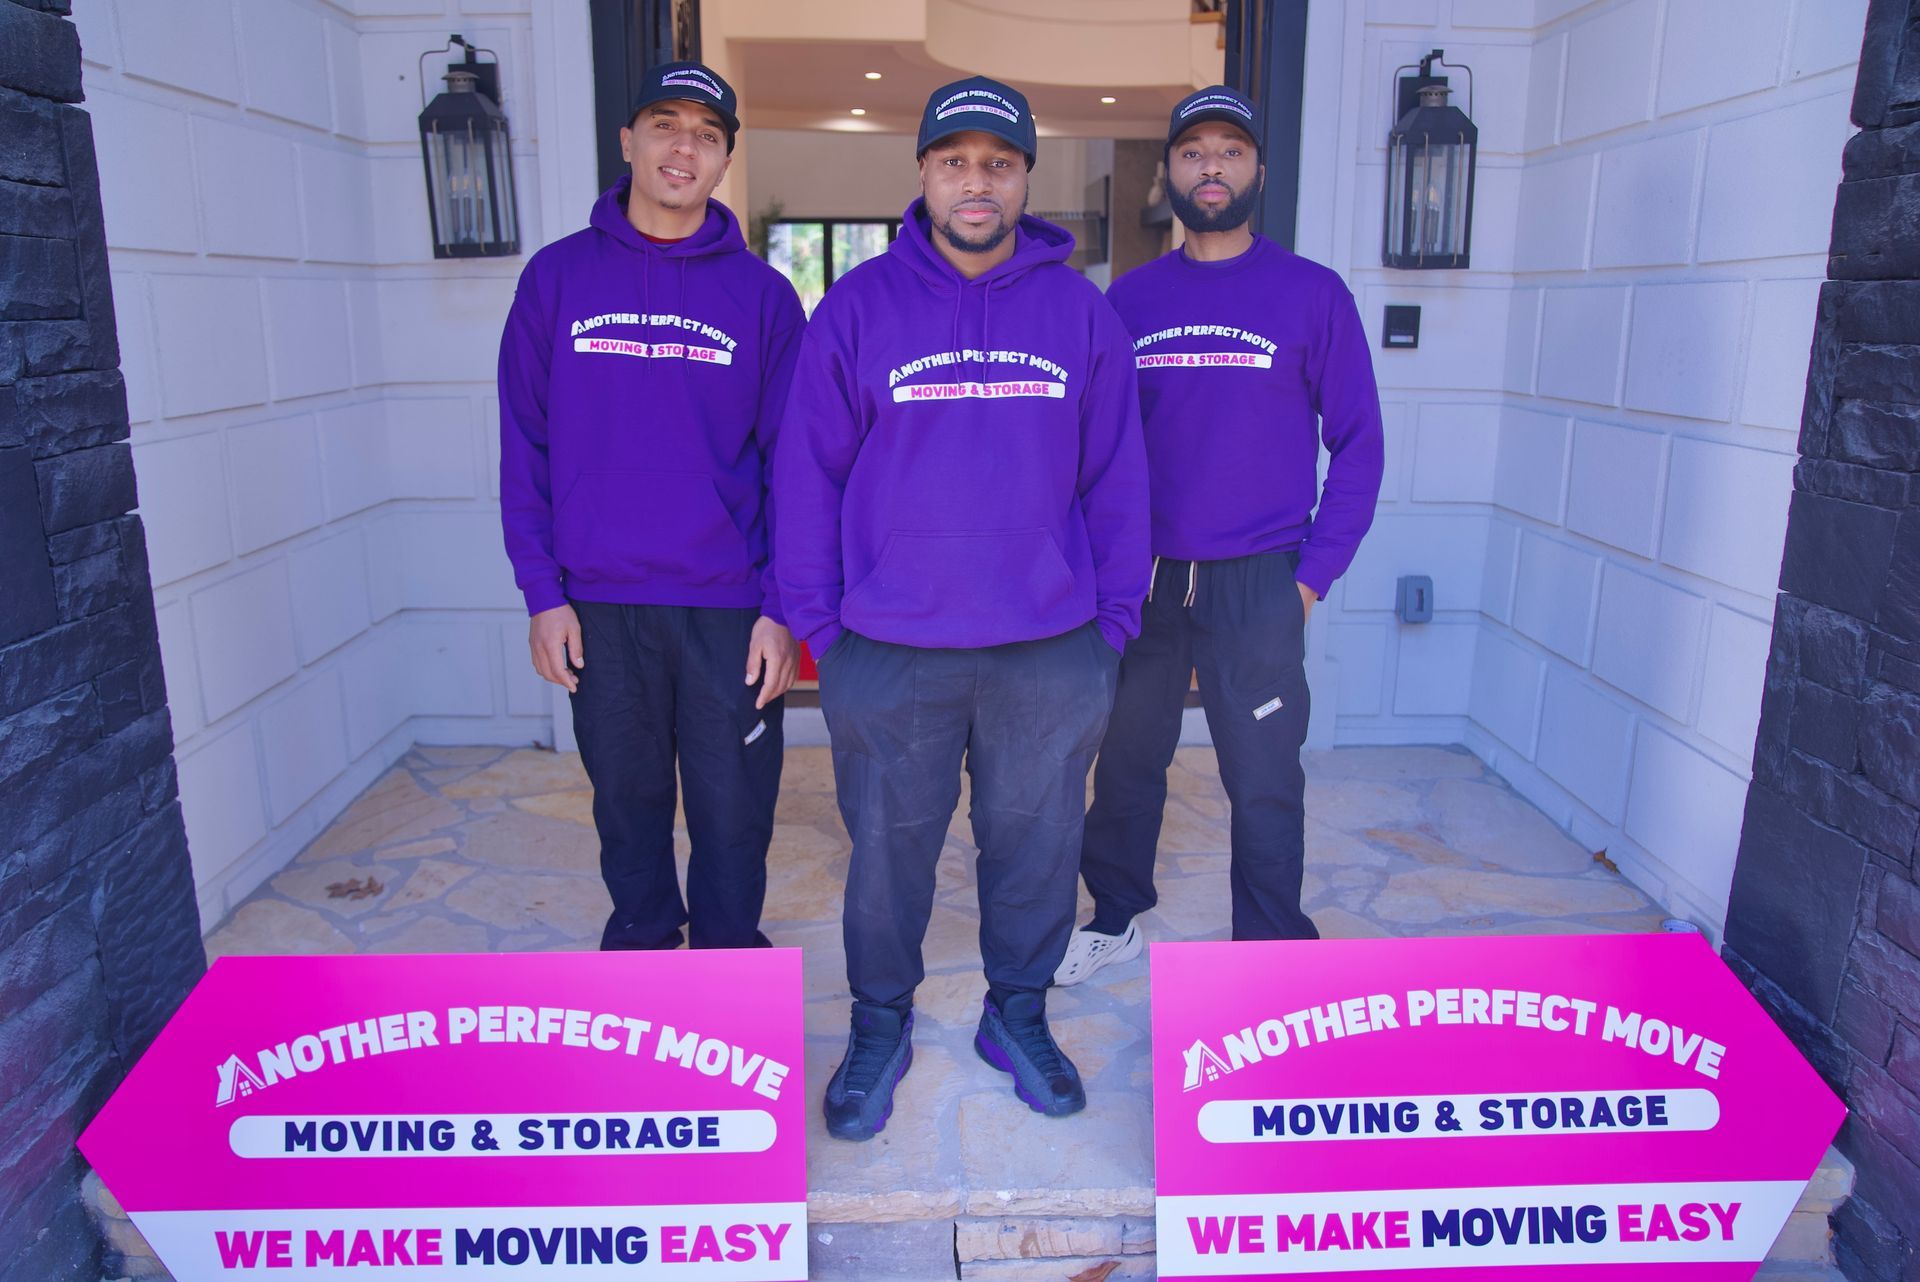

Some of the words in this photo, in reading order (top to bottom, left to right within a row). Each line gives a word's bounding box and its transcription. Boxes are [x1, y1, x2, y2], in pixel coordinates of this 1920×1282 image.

[690, 69, 712, 82] PERFECT
[935, 91, 968, 115] ANOTHER
[969, 90, 1002, 102] PERFECT
[1001, 99, 1020, 117] MOVE
[944, 105, 970, 116] MOVING
[980, 105, 1011, 119] STORAGE
[571, 313, 640, 337] ANOTHER
[700, 324, 738, 352] MOVE
[589, 340, 642, 355] MOVING
[1133, 327, 1182, 352] NOTHER
[1184, 325, 1241, 338] PERFECT
[1240, 331, 1278, 355] MOVE
[889, 351, 962, 388] ANOTHER
[1029, 354, 1069, 382] MOVE
[1139, 355, 1183, 367] MOVING
[1187, 355, 1195, 365] &
[1199, 355, 1256, 365] STORAGE
[911, 384, 966, 399] MOVING
[970, 384, 979, 395] &
[983, 383, 1050, 397] STORAGE
[215, 1010, 440, 1108] ANOTHER
[448, 1006, 652, 1056] PERFECT
[654, 1024, 790, 1101] MOVE
[1183, 993, 1400, 1093] ANOTHER
[1406, 988, 1596, 1036] PERFECT
[1602, 1005, 1727, 1080] MOVE
[1253, 1101, 1420, 1136] MOVING
[1434, 1100, 1463, 1132] &
[1479, 1095, 1668, 1131] STORAGE
[284, 1119, 456, 1152] MOVING
[471, 1119, 500, 1151] &
[518, 1116, 720, 1150] STORAGE
[214, 1229, 294, 1270] WE
[305, 1228, 443, 1268] MAKE
[454, 1225, 648, 1266] MOVING
[660, 1222, 792, 1264] EASY
[1186, 1215, 1265, 1255] WE
[1276, 1211, 1411, 1252] MAKE
[1422, 1204, 1607, 1248] MOVING
[1617, 1202, 1742, 1243] EASY
